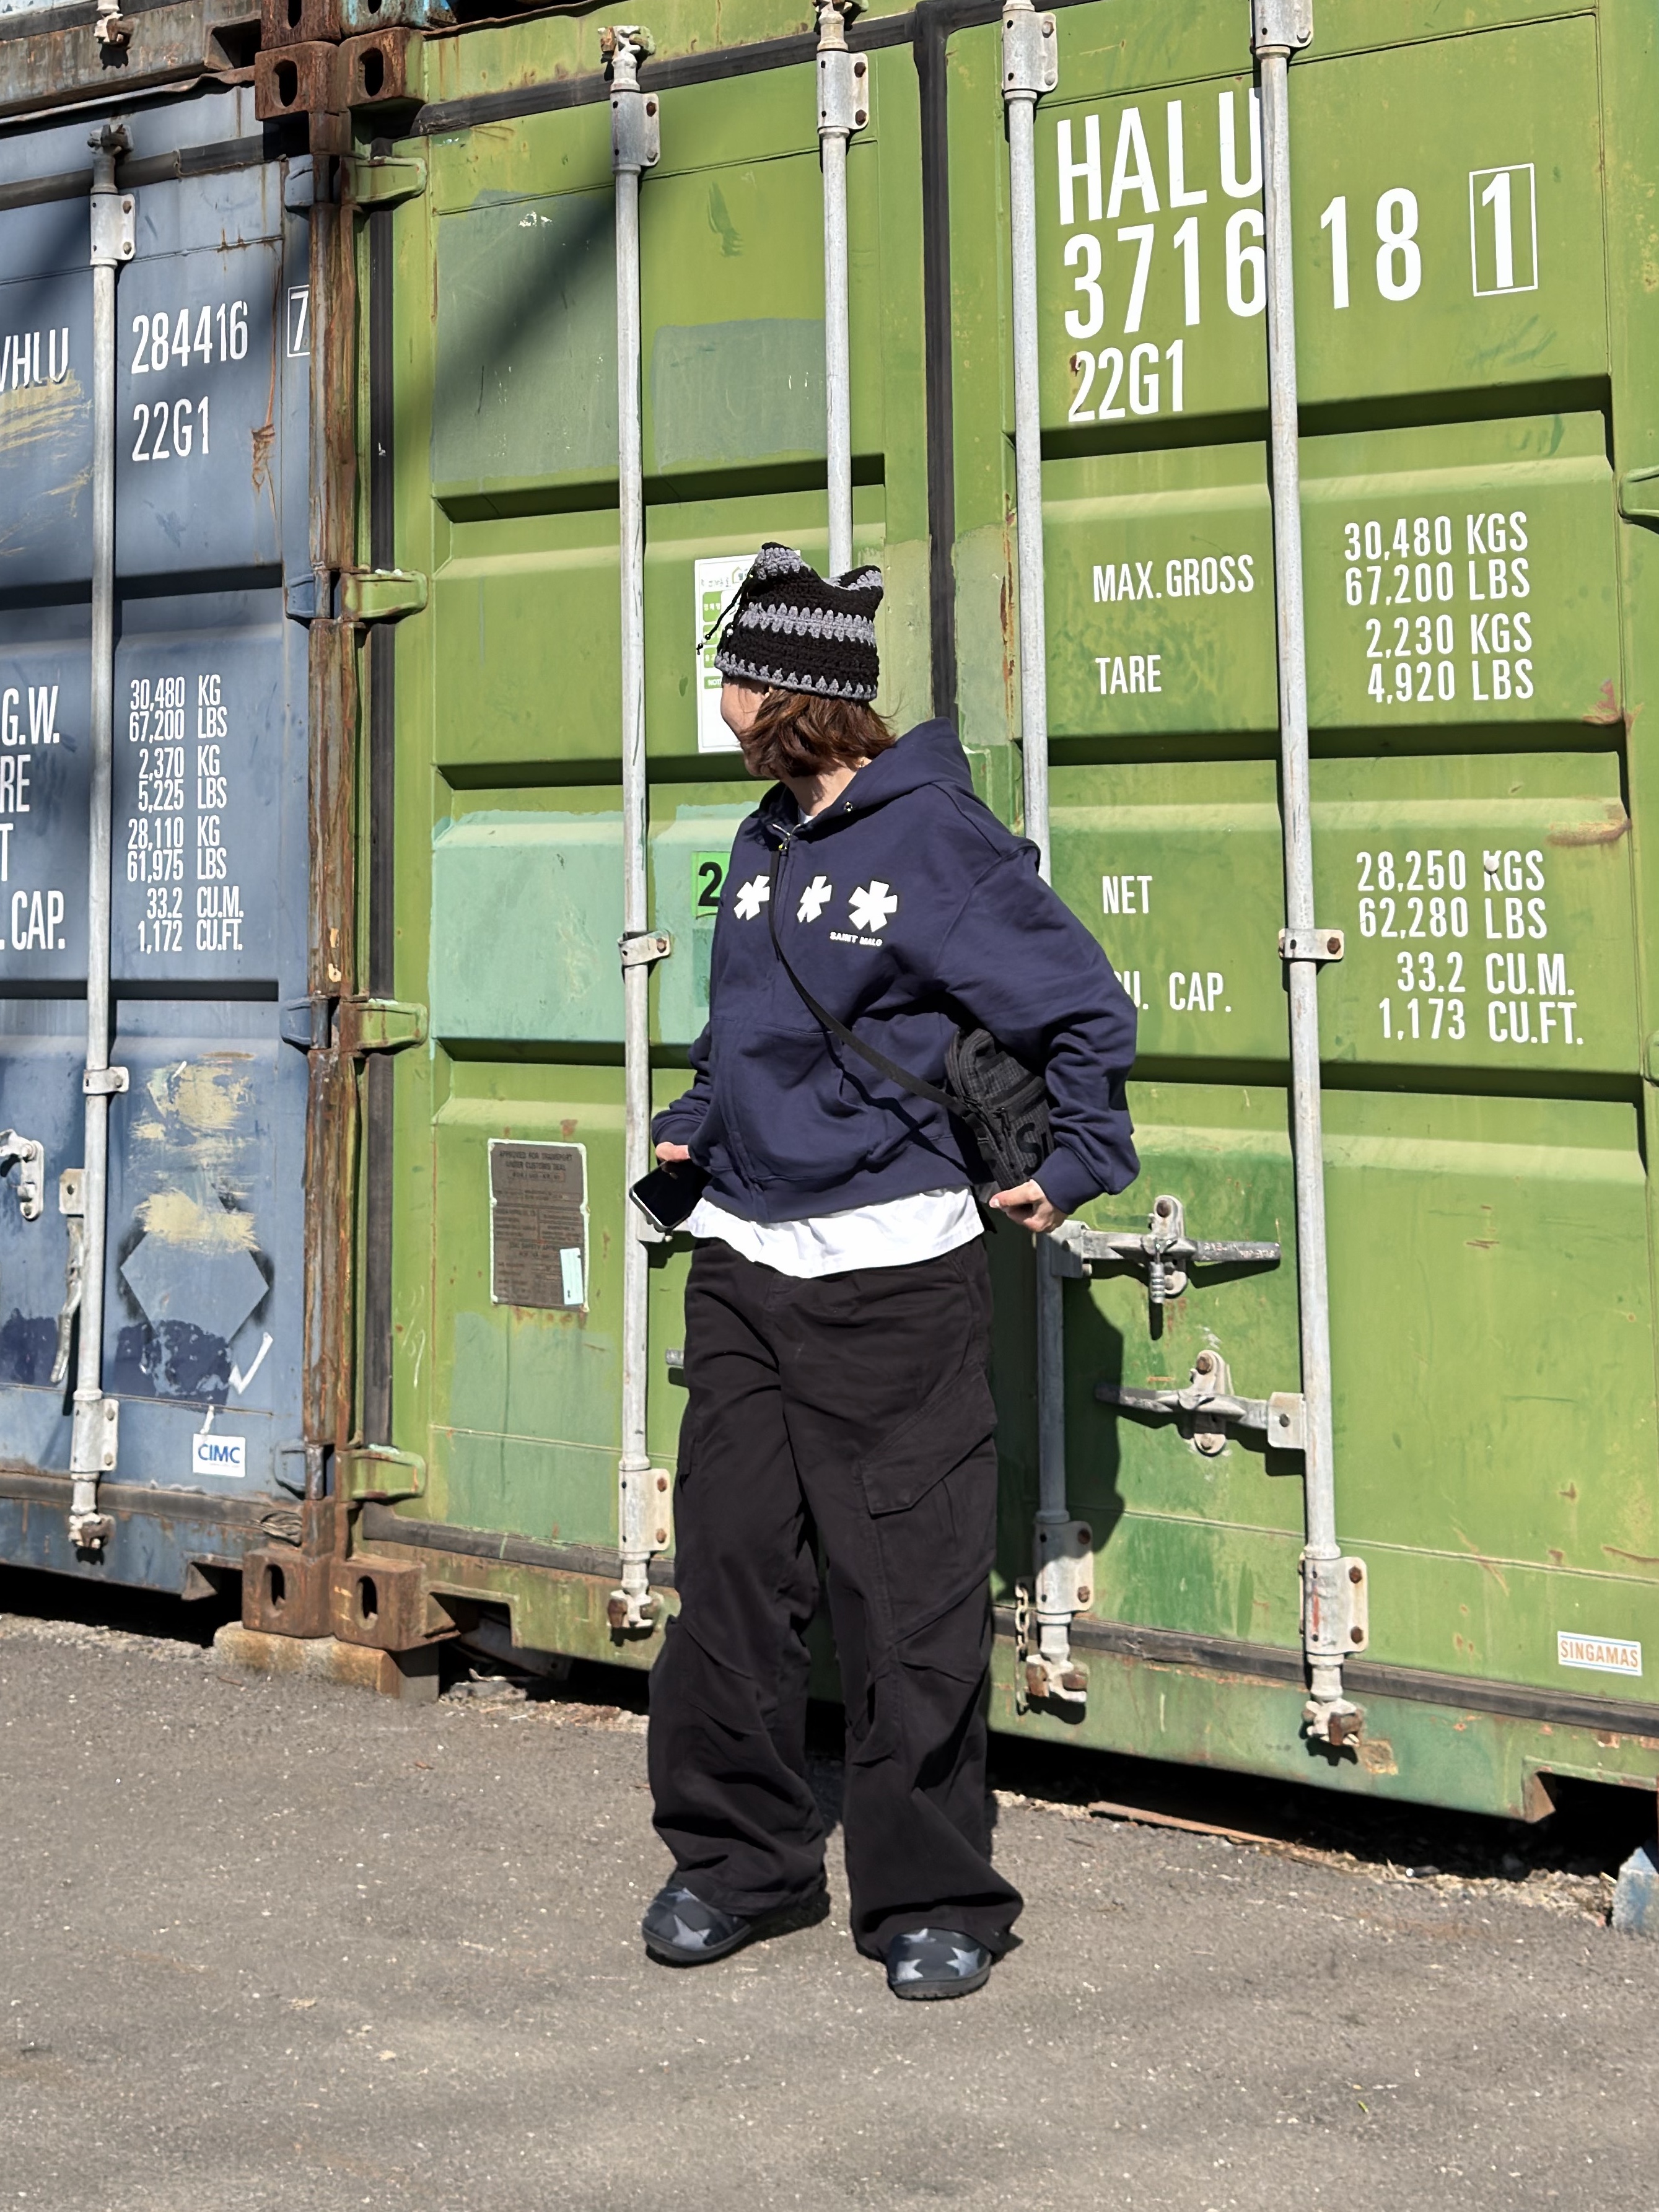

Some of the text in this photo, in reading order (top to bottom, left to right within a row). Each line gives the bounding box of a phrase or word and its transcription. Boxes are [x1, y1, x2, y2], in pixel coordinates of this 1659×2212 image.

[1057, 87, 1263, 225] HALU
[1482, 172, 1513, 288] 1
[130, 291, 310, 374] 284416 7
[1068, 339, 1183, 422] 22G1
[131, 396, 209, 461] 22G1
[1344, 511, 1528, 561] 30,480 KGS
[1346, 557, 1530, 606] 67,200 LBS
[1366, 611, 1532, 658] 2,230 KGS
[130, 674, 221, 712] 30,480 KG
[1095, 655, 1162, 694] TARE
[1368, 658, 1534, 704] 4,920 LBS
[129, 706, 227, 744] 67,200 LBS
[139, 744, 221, 782] 2,370 KG
[138, 776, 227, 811] 5,225 LBS
[128, 815, 221, 851] 28,110 KG
[127, 847, 227, 884] 61,975 LBS
[1357, 849, 1544, 892] 28,250 KGS
[146, 885, 244, 920] 33.2 CU.M.
[1102, 875, 1152, 914] NET
[11, 890, 66, 950] CAP.
[138, 918, 243, 955] 1,172 CU.FT.
[1359, 896, 1547, 939] 62,280 LBS
[829, 931, 883, 947] SAINT MALO
[1169, 972, 1232, 1012] CAP.
[1397, 951, 1575, 995] 33.2 CU.M.
[1379, 997, 1583, 1045] 1,173 CU.FT.
[198, 1443, 240, 1464] CIMC
[1560, 1640, 1639, 1668] SINGAMAS
